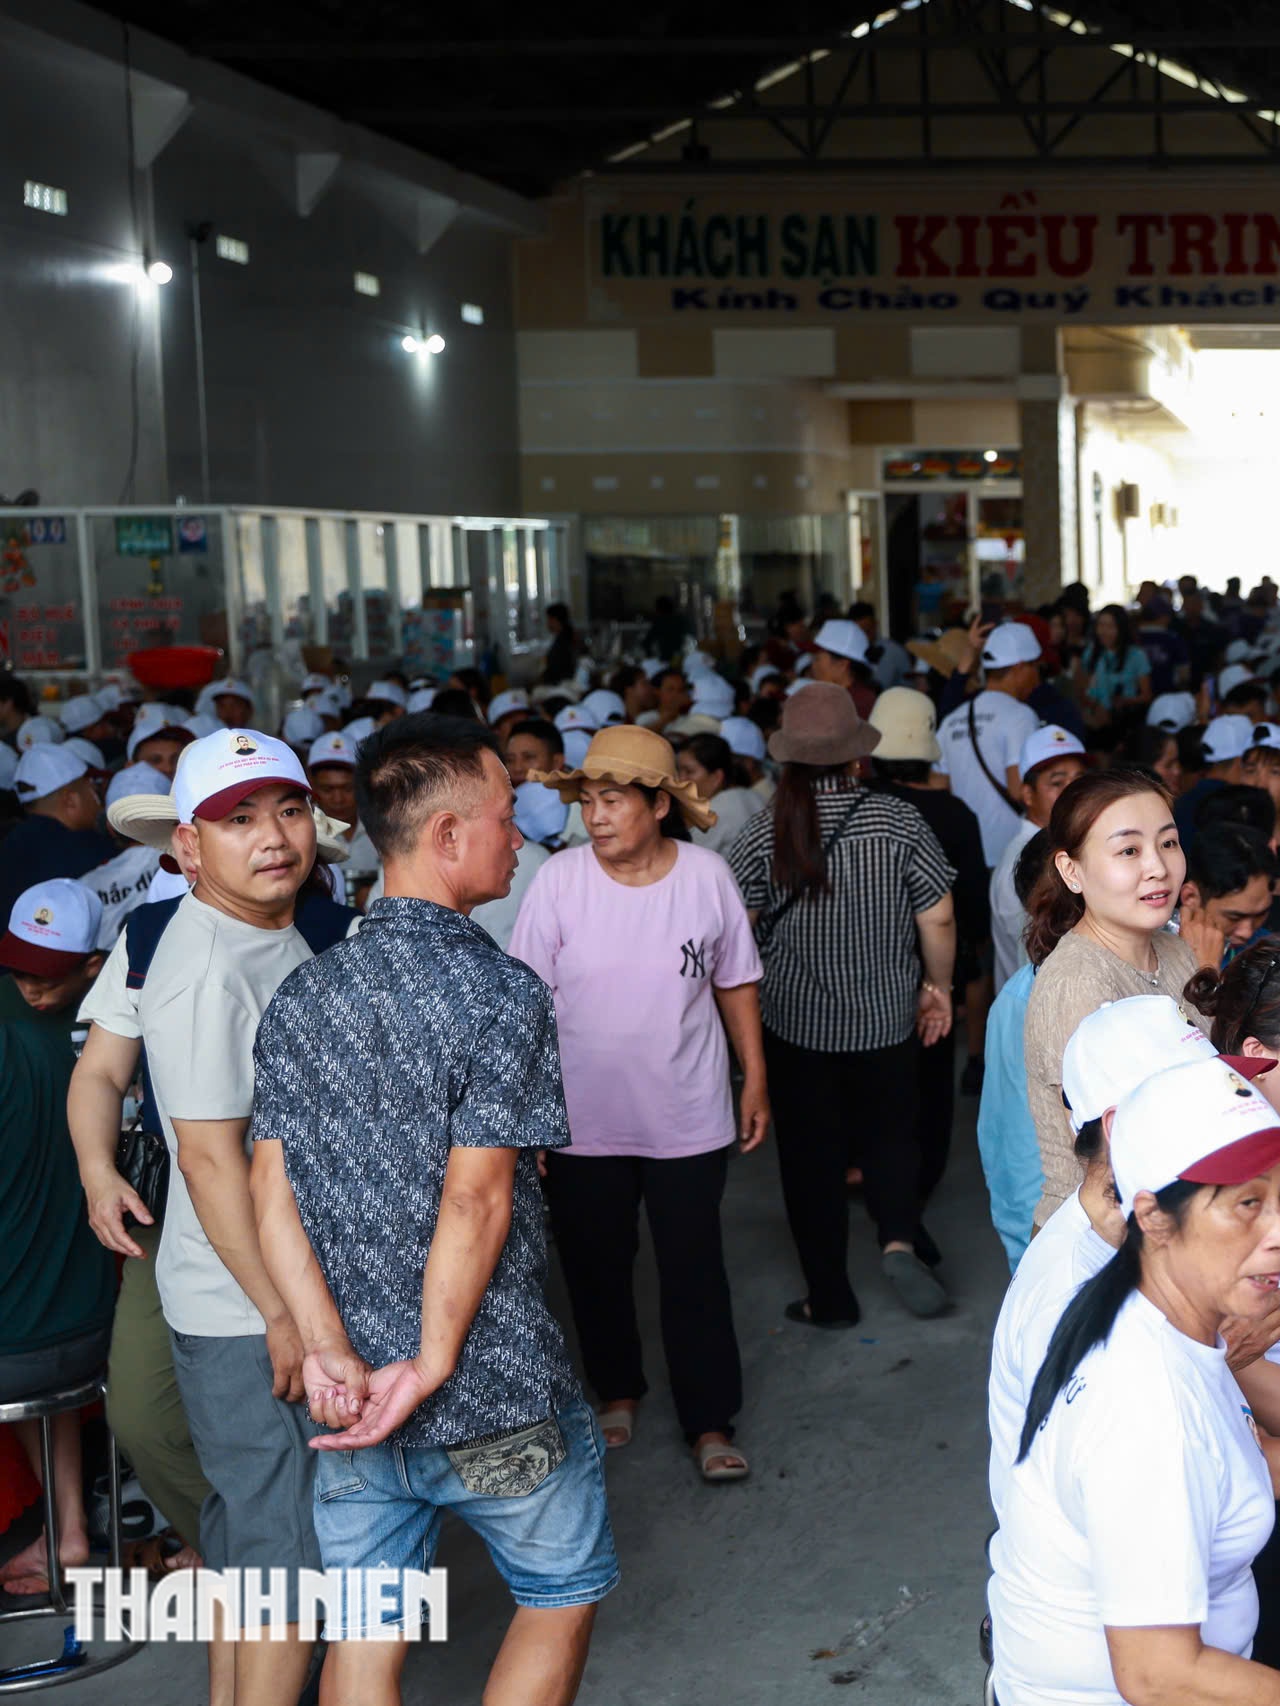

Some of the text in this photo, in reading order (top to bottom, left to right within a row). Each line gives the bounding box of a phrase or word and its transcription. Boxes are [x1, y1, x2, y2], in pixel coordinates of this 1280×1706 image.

[602, 197, 768, 279] KHÁCH
[781, 213, 878, 287] SẠN
[894, 191, 1099, 279] KIỀU
[673, 286, 796, 311] Kính
[818, 286, 959, 311] Chào
[984, 286, 1090, 315] Quý
